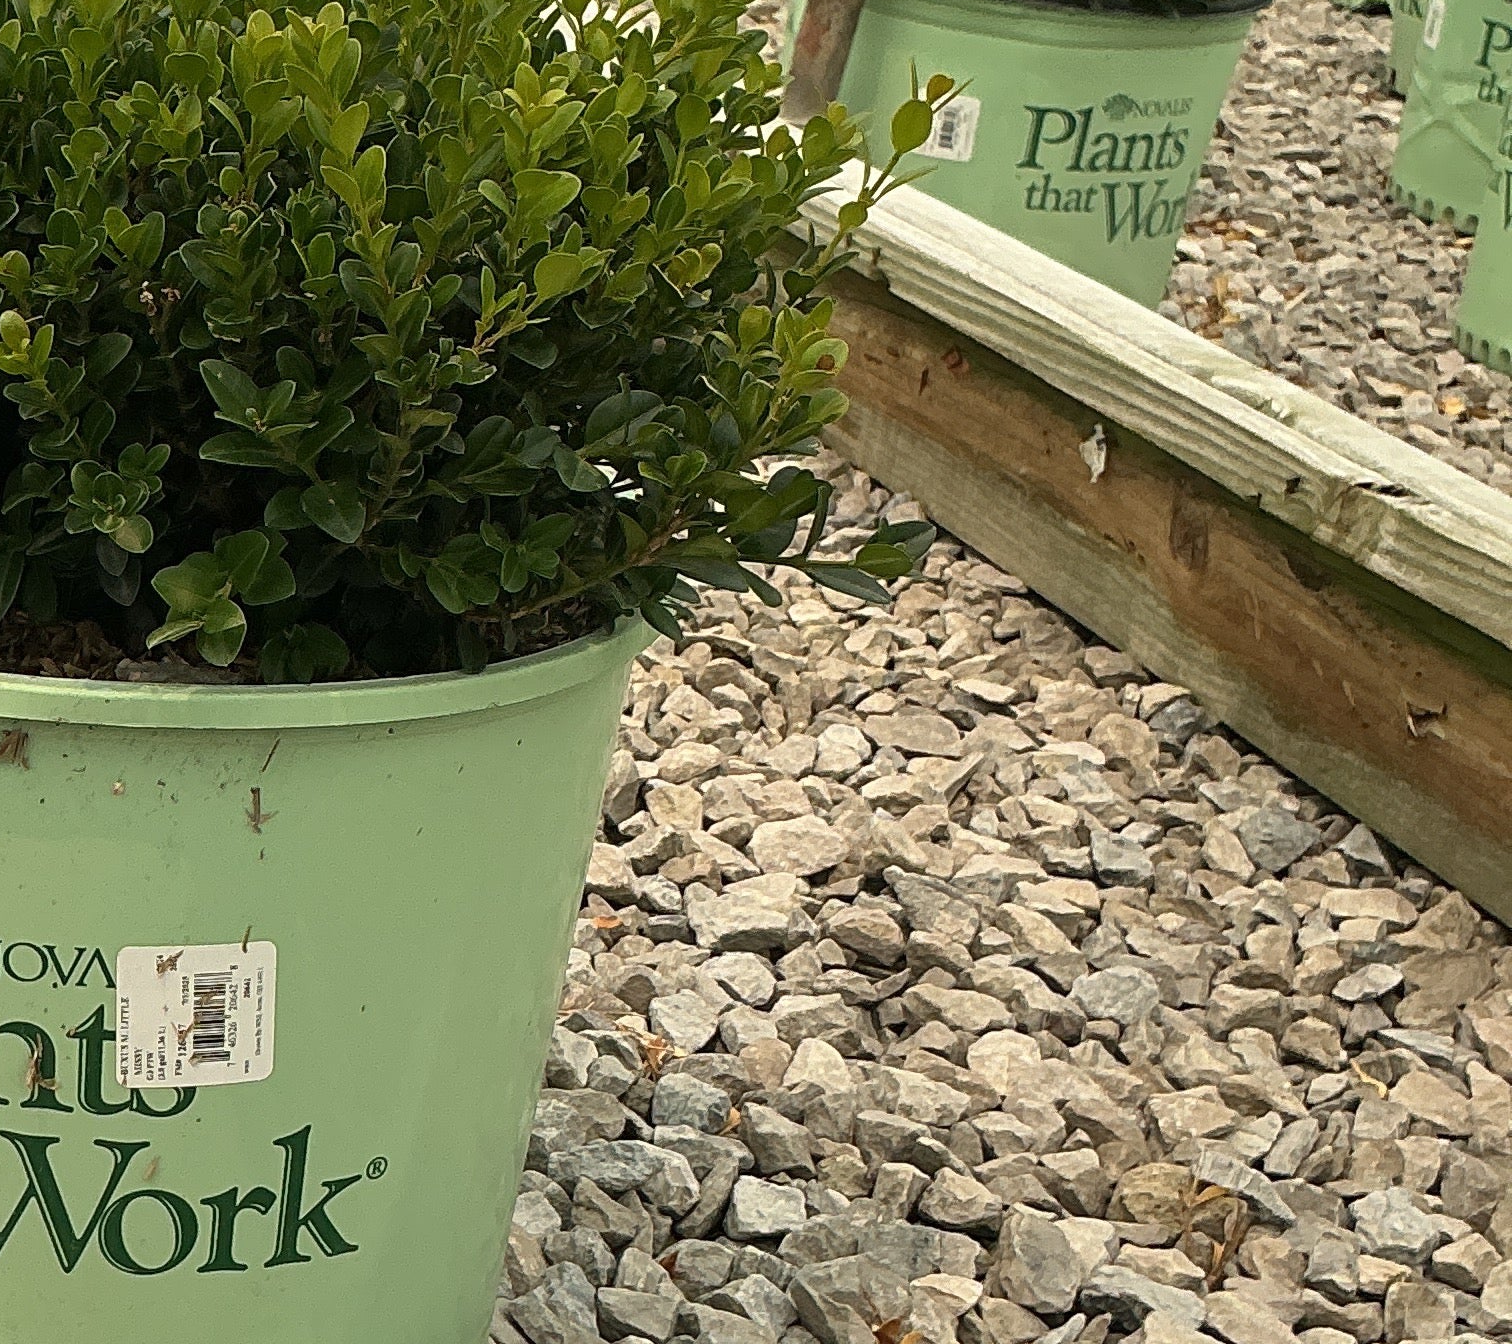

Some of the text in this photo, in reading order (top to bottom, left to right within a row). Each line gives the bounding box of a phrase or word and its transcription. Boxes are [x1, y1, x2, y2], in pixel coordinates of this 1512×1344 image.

[1015, 105, 1189, 172] Plants
[1024, 168, 1196, 244] that Wor
